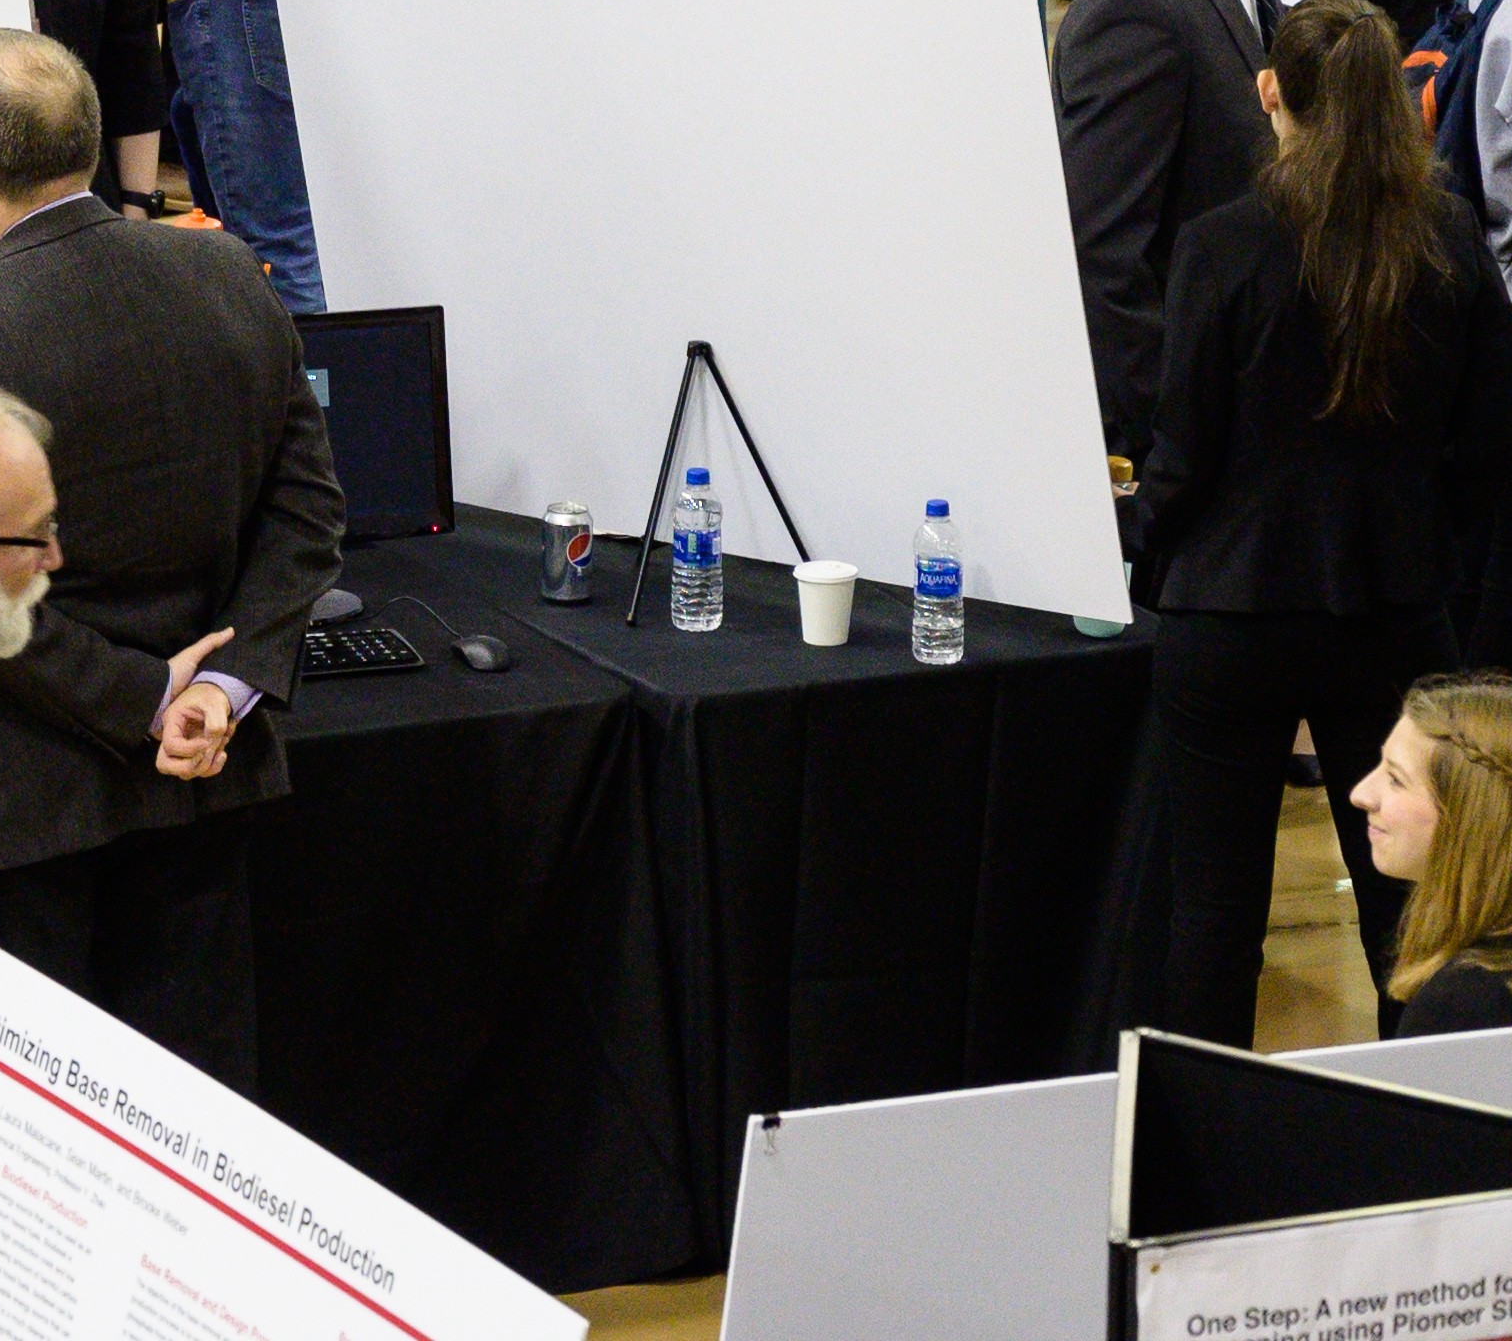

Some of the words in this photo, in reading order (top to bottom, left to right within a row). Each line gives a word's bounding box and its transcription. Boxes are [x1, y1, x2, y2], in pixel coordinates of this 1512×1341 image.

[66, 1061, 109, 1108] Base
[115, 1089, 190, 1157] Removal
[193, 1142, 209, 1173] in
[214, 1153, 296, 1228] Biodiesel
[299, 1207, 396, 1294] Production
[1187, 1314, 1237, 1337] One
[1245, 1307, 1308, 1329] Step:
[1315, 1298, 1331, 1321] A
[1339, 1296, 1388, 1316] new
[1396, 1277, 1486, 1309] method
[1318, 1322, 1384, 1341] using
[1393, 1309, 1481, 1337] Pioneer
